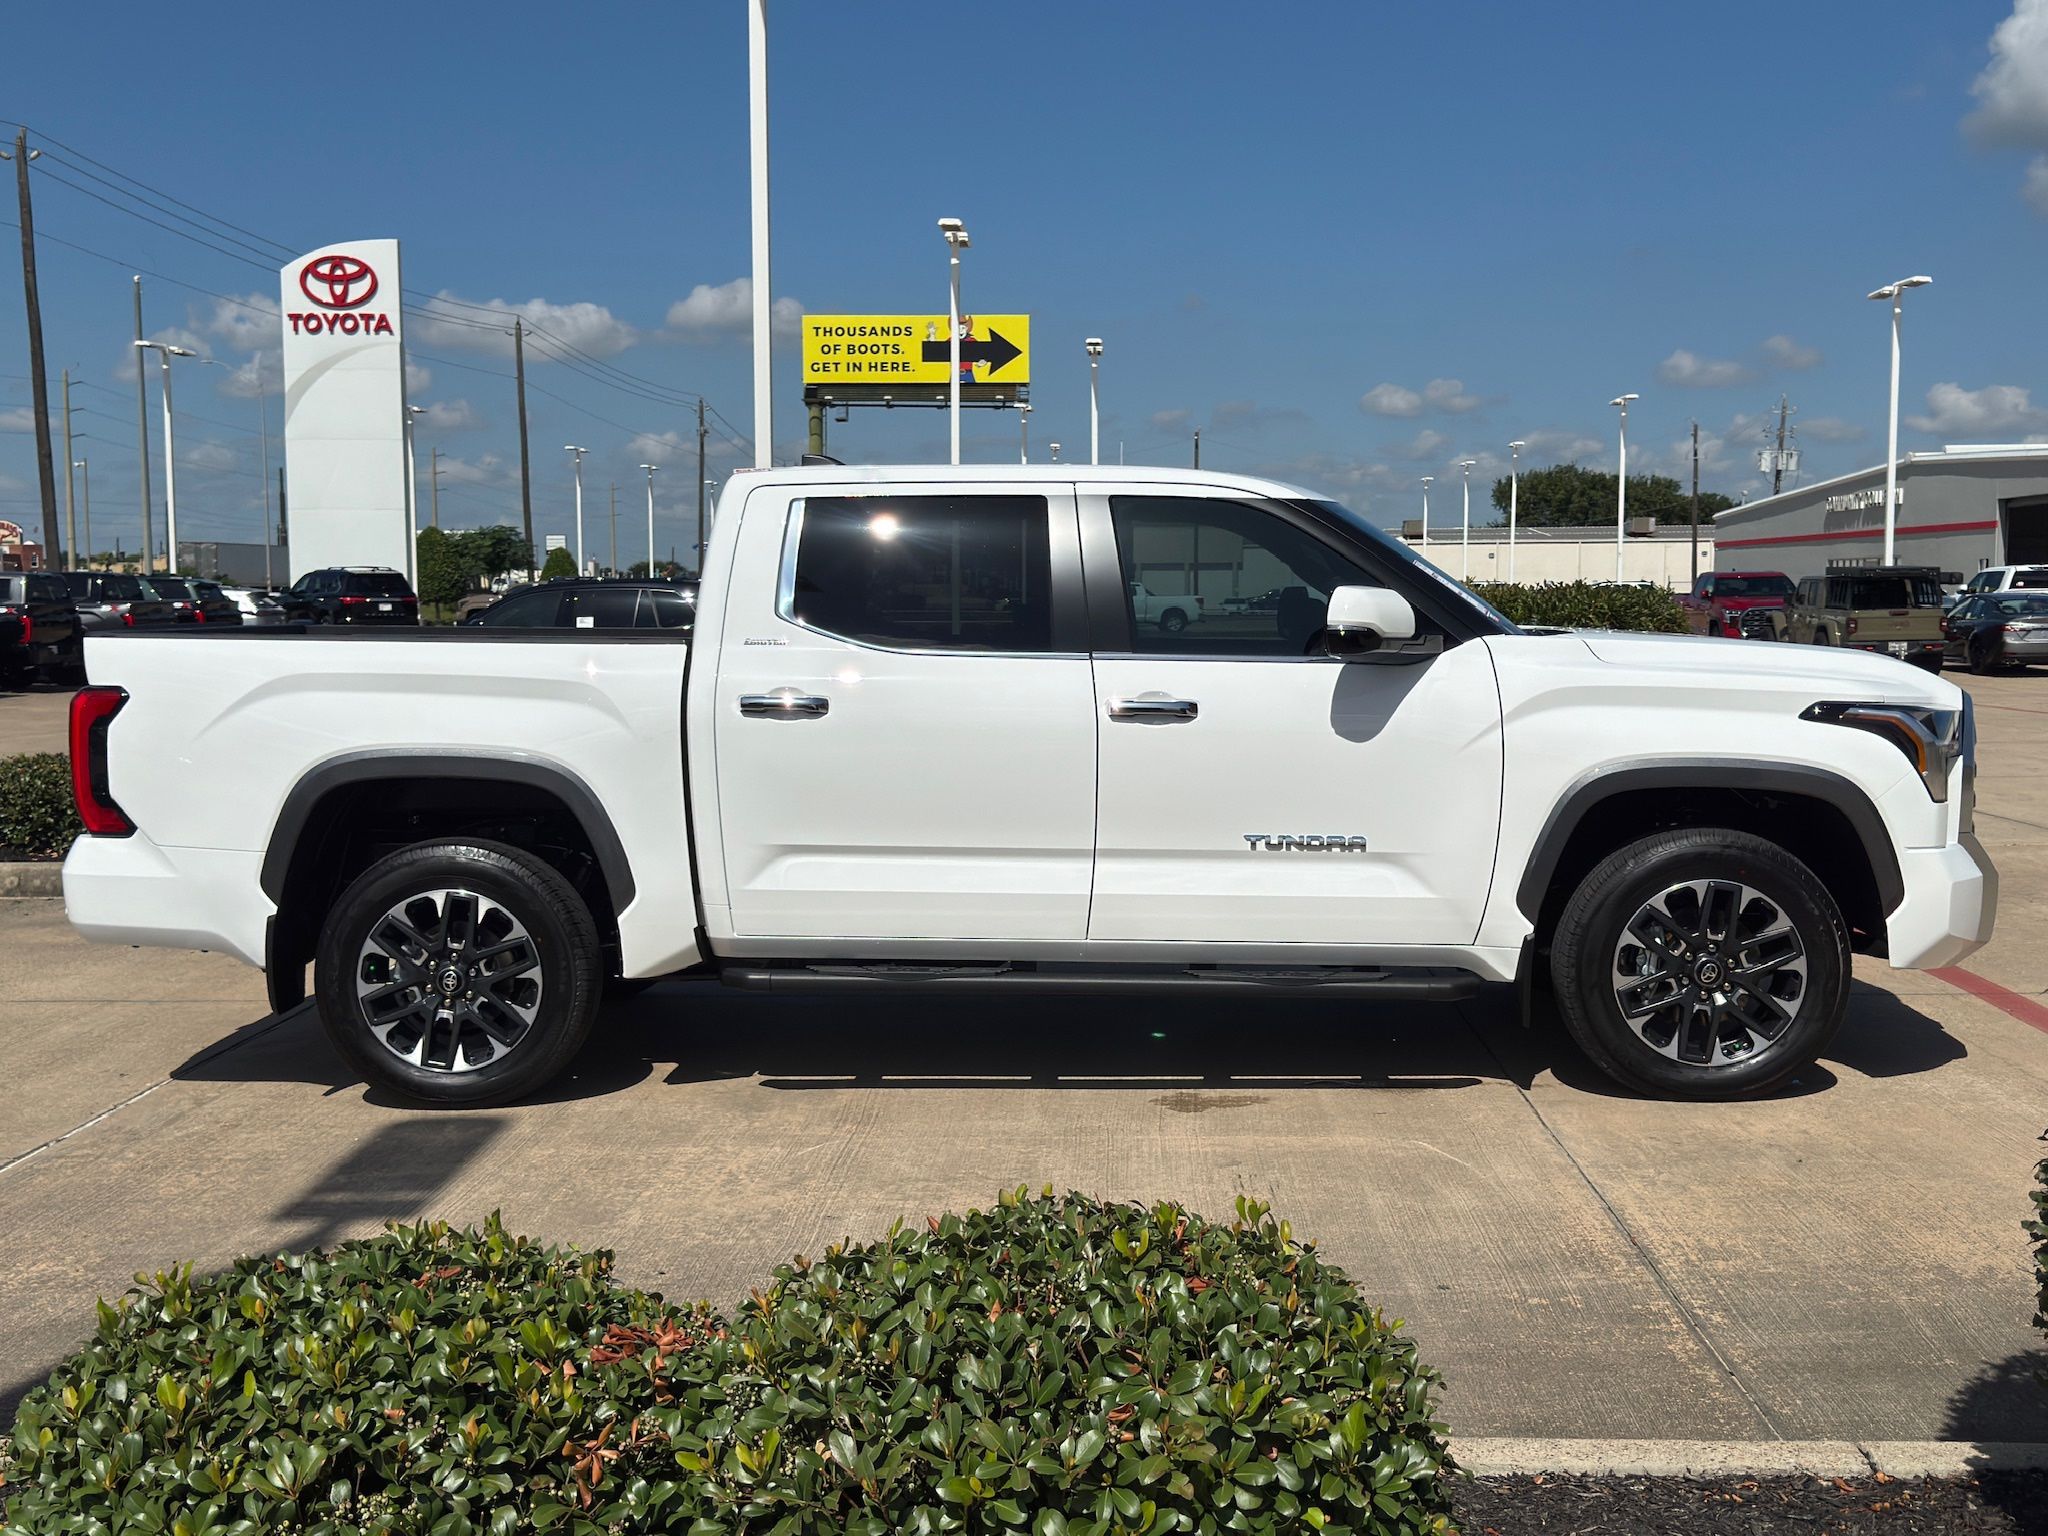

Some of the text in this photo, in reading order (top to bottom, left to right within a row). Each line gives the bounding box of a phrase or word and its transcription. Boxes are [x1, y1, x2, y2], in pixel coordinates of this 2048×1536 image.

[287, 312, 394, 336] TOYOTA
[813, 326, 913, 337] THOUSANDS
[821, 344, 905, 355] OF BOOTS.
[810, 362, 916, 373] GET IN HERE.
[1243, 834, 1367, 853] TUNDRA
